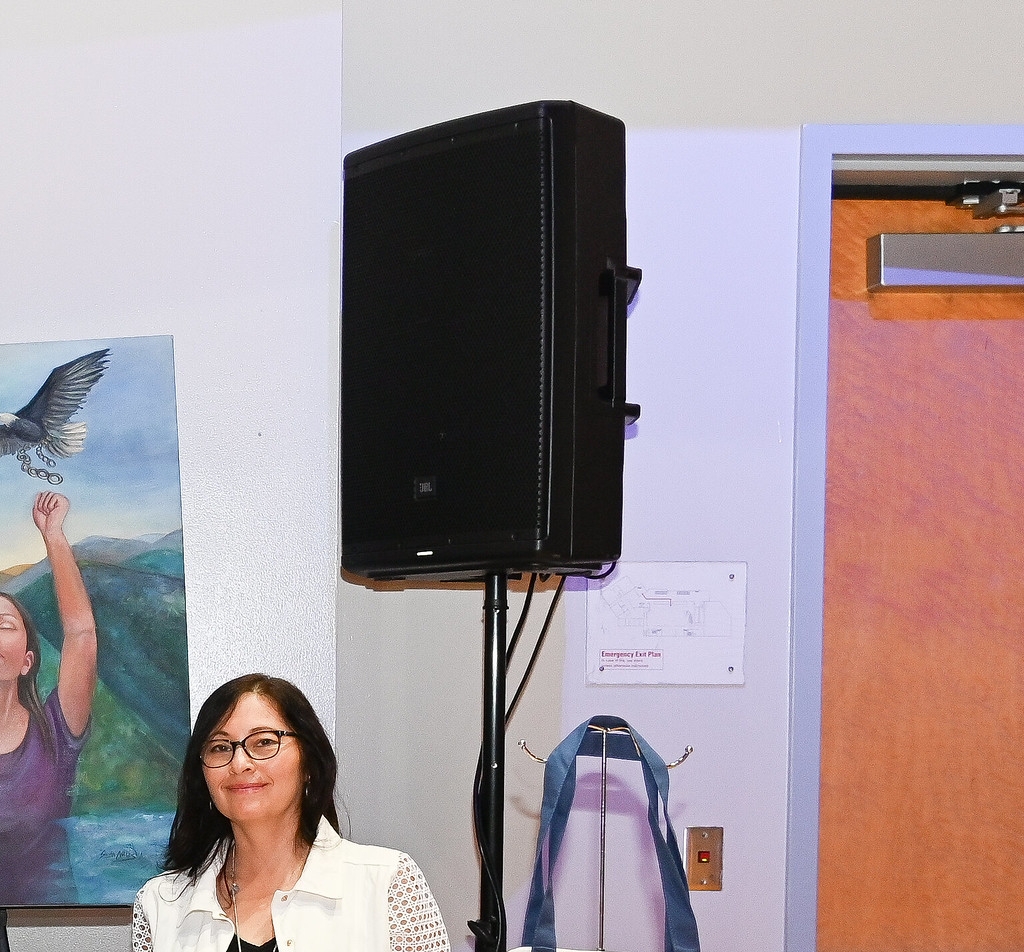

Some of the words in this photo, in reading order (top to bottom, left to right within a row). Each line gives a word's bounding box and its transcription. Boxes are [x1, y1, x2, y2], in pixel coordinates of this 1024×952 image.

[419, 482, 433, 493] JBL
[601, 650, 634, 659] Emergency
[635, 650, 647, 658] Exit
[647, 650, 662, 658] Plan
